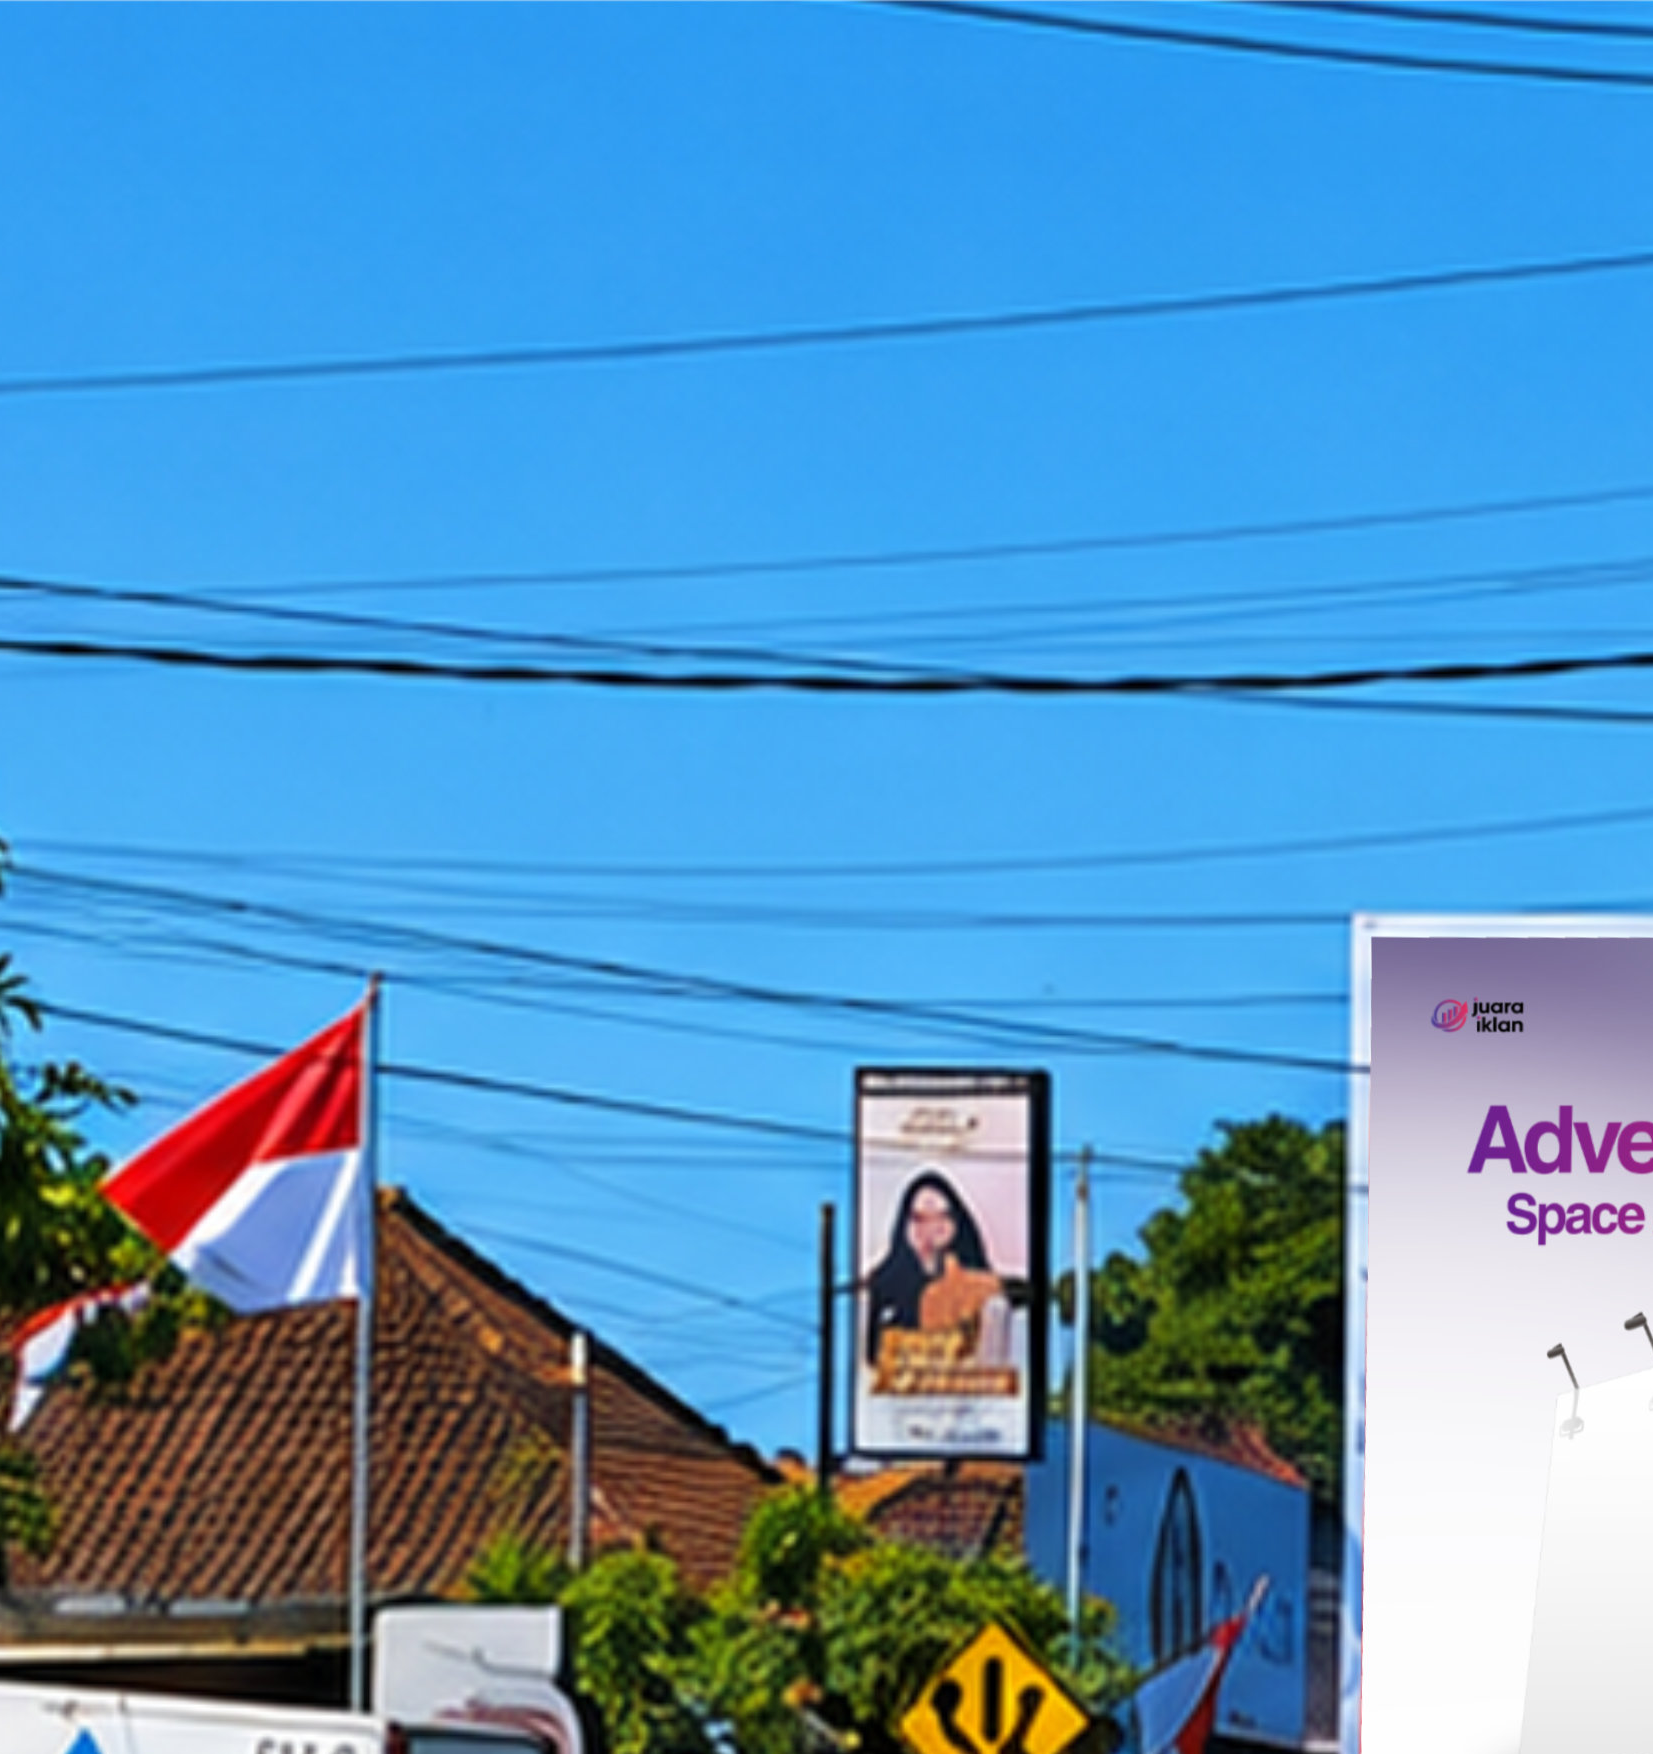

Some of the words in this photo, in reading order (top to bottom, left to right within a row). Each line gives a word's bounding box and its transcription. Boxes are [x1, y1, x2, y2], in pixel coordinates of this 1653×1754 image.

[1472, 997, 1524, 1017] juara
[1476, 1016, 1524, 1033] iklan
[1506, 1192, 1645, 1245] Space
